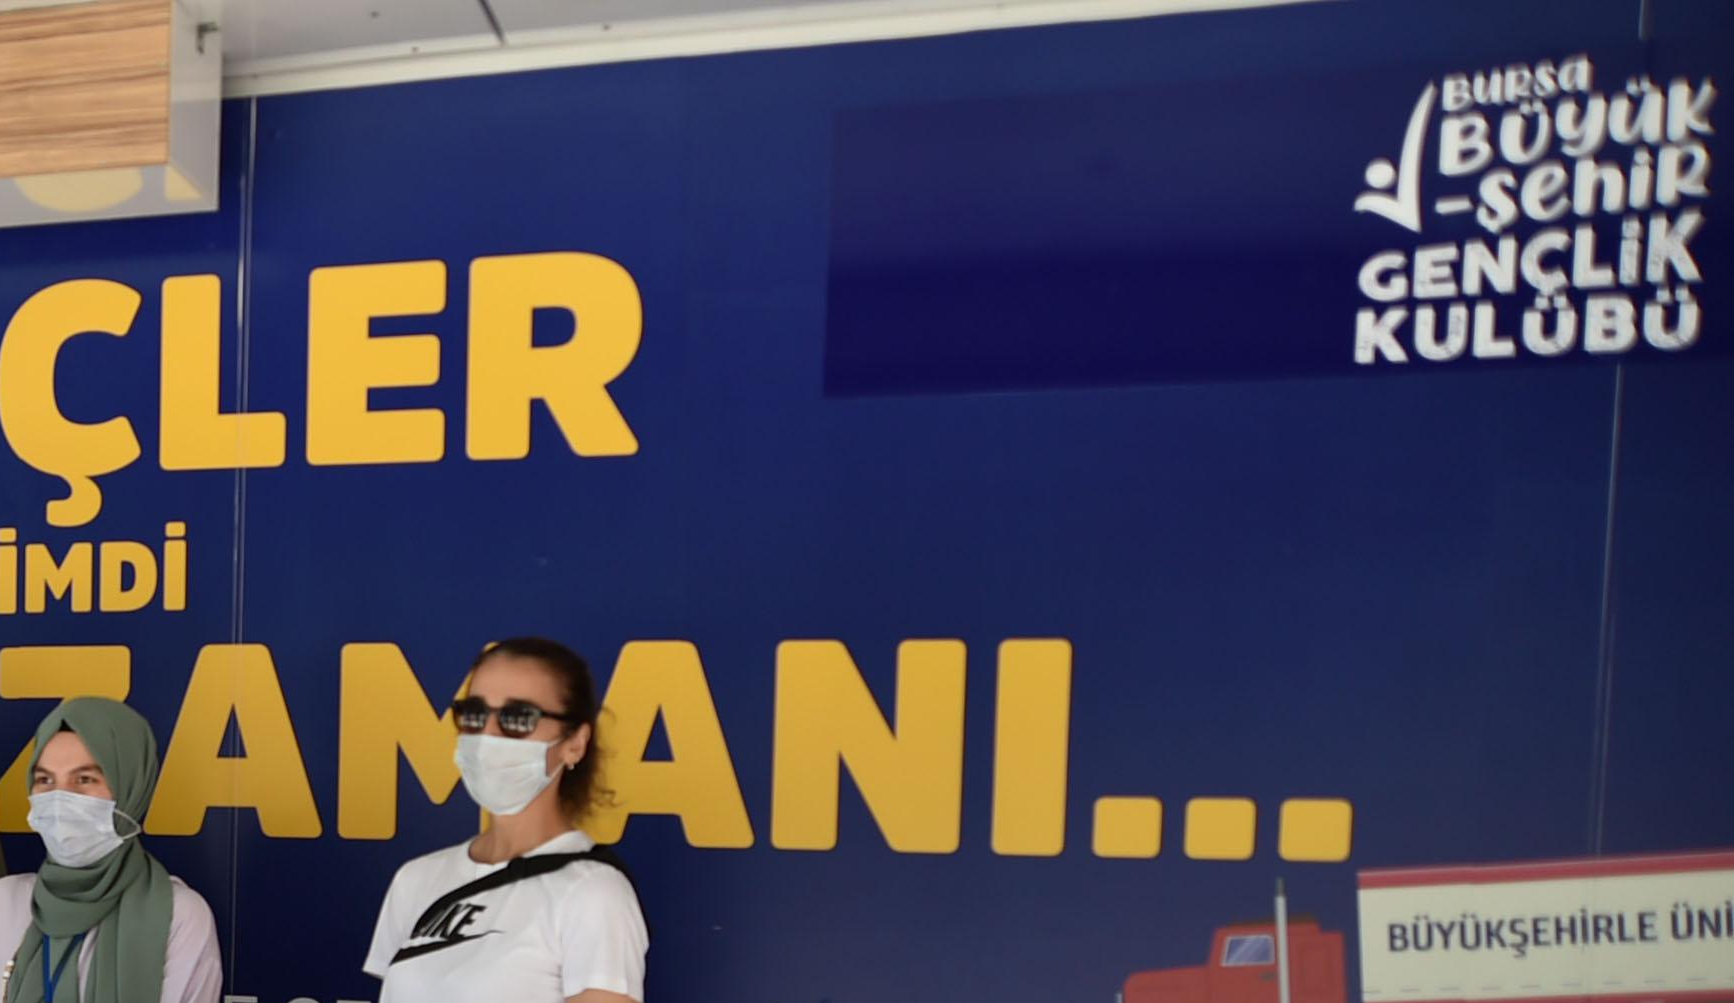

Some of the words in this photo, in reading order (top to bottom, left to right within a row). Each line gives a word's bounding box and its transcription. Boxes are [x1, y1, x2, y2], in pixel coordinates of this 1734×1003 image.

[1357, 207, 1704, 298] GENÇLİK
[1354, 285, 1701, 365] KULÜBÜ
[1388, 906, 1658, 958] BÜYÜKŞEHİRLE
